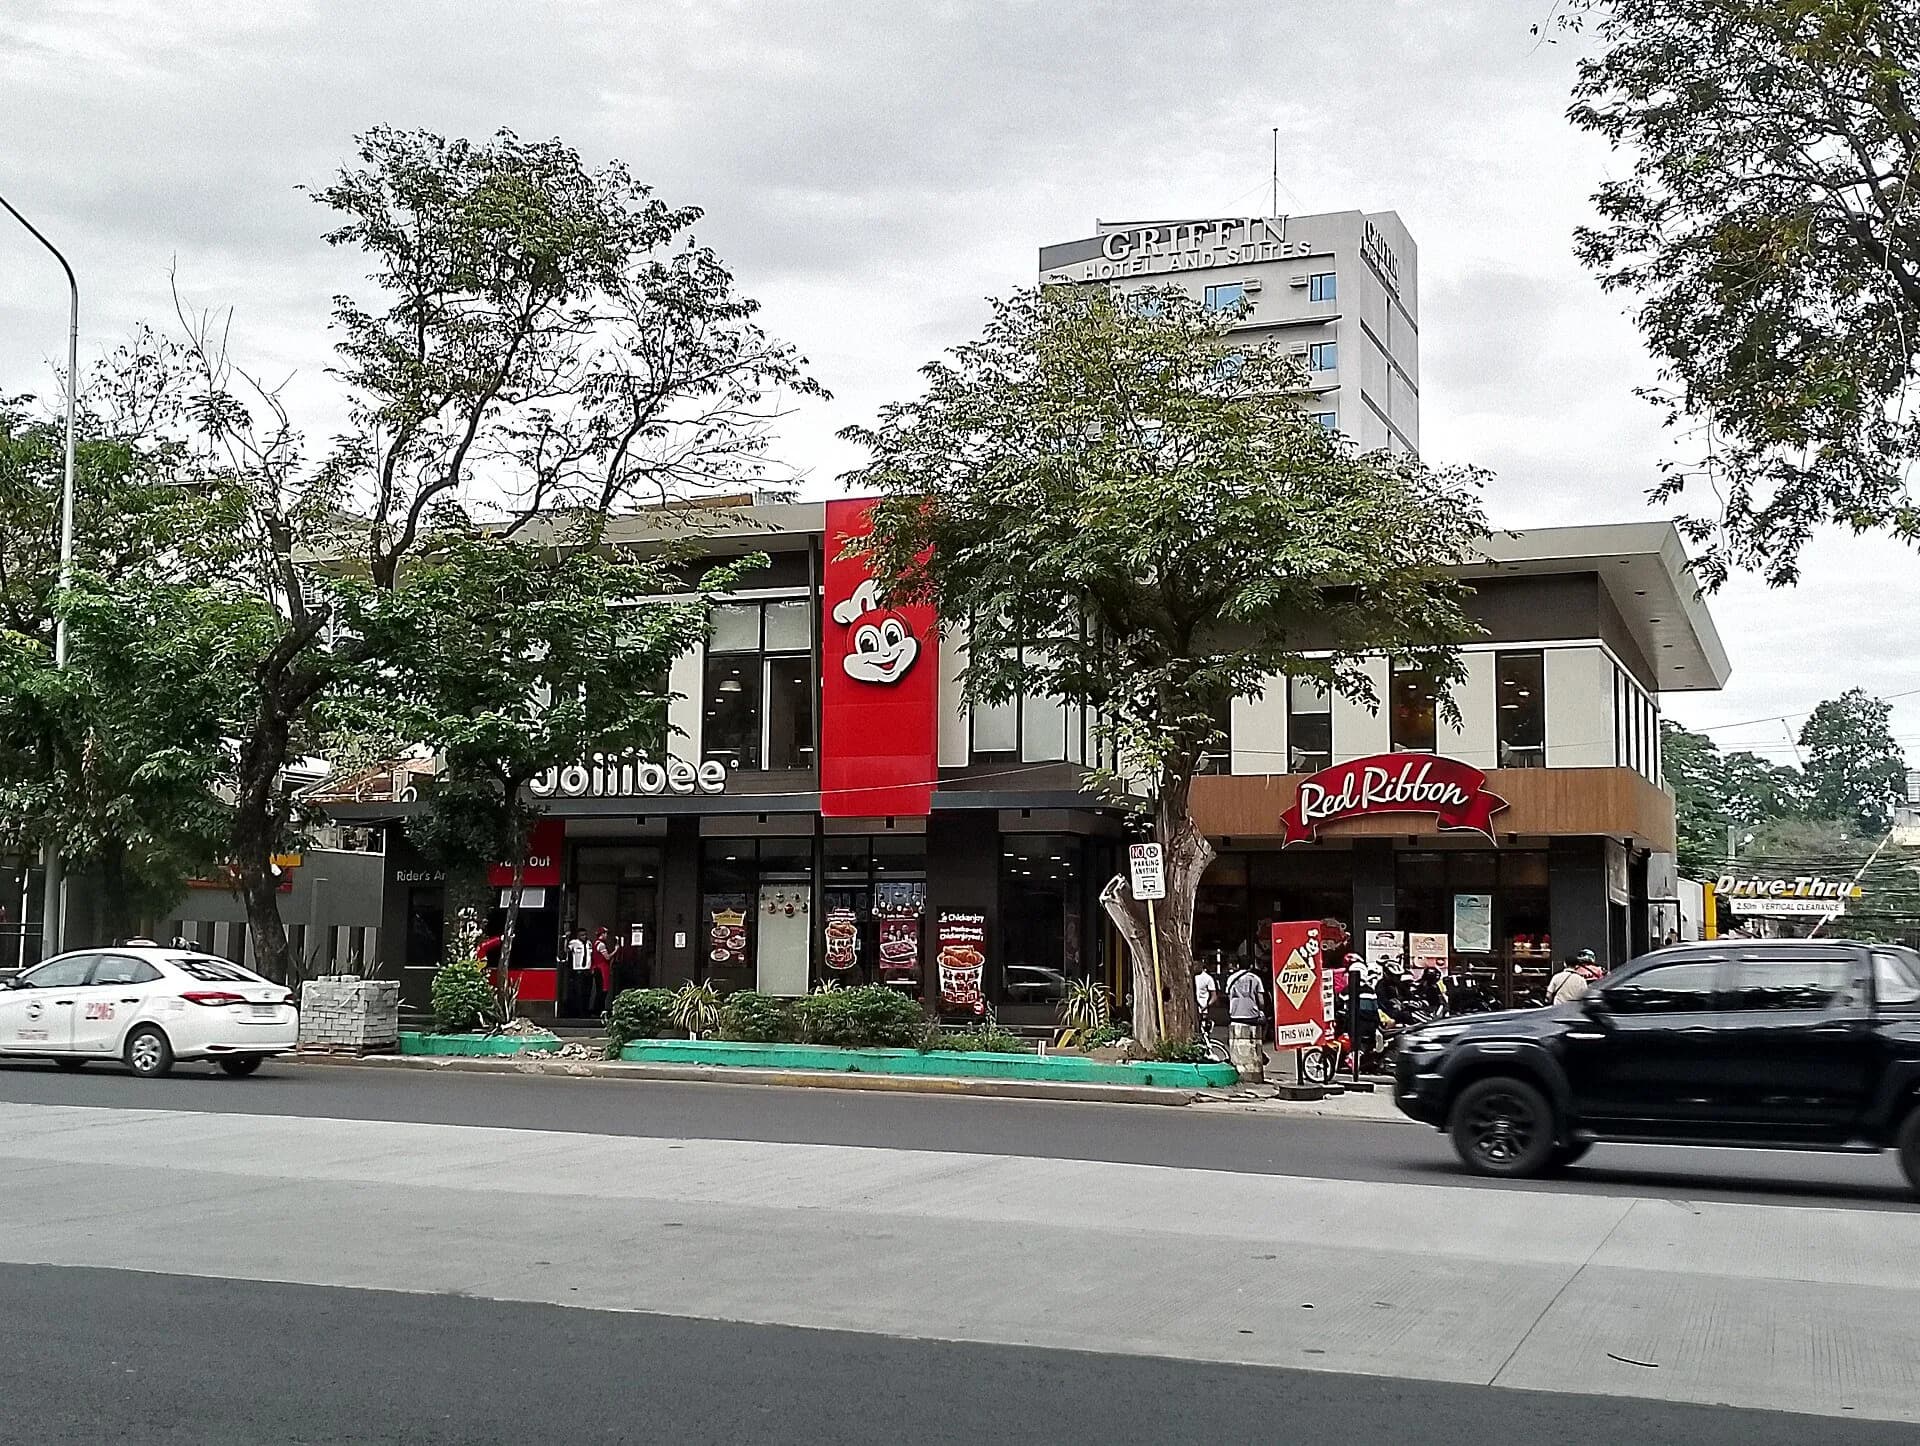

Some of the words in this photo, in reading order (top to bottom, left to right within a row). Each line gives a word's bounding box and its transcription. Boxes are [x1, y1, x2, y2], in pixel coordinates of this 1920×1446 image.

[1102, 214, 1289, 261] GRIFFIN
[1083, 257, 1151, 280] HOTEL
[1170, 250, 1215, 271] AND
[1227, 240, 1312, 265] SUITES
[529, 747, 726, 796] Jollibee
[1300, 773, 1359, 826] Red
[1362, 762, 1468, 809] Ribbon
[1131, 847, 1144, 858] NO
[529, 856, 550, 867] Out
[1134, 859, 1159, 867] PARKING
[396, 870, 430, 882] Rider's
[1136, 867, 1159, 875] ANYTIME
[1713, 875, 1855, 898] Drive-Thru
[1761, 903, 1795, 911] VERTICAL
[1797, 903, 1840, 912] CLEARANCE
[1282, 972, 1308, 983] Drive
[1286, 983, 1308, 994] Thru
[1281, 1029, 1296, 1040] THIS
[1298, 1027, 1314, 1038] WAY
